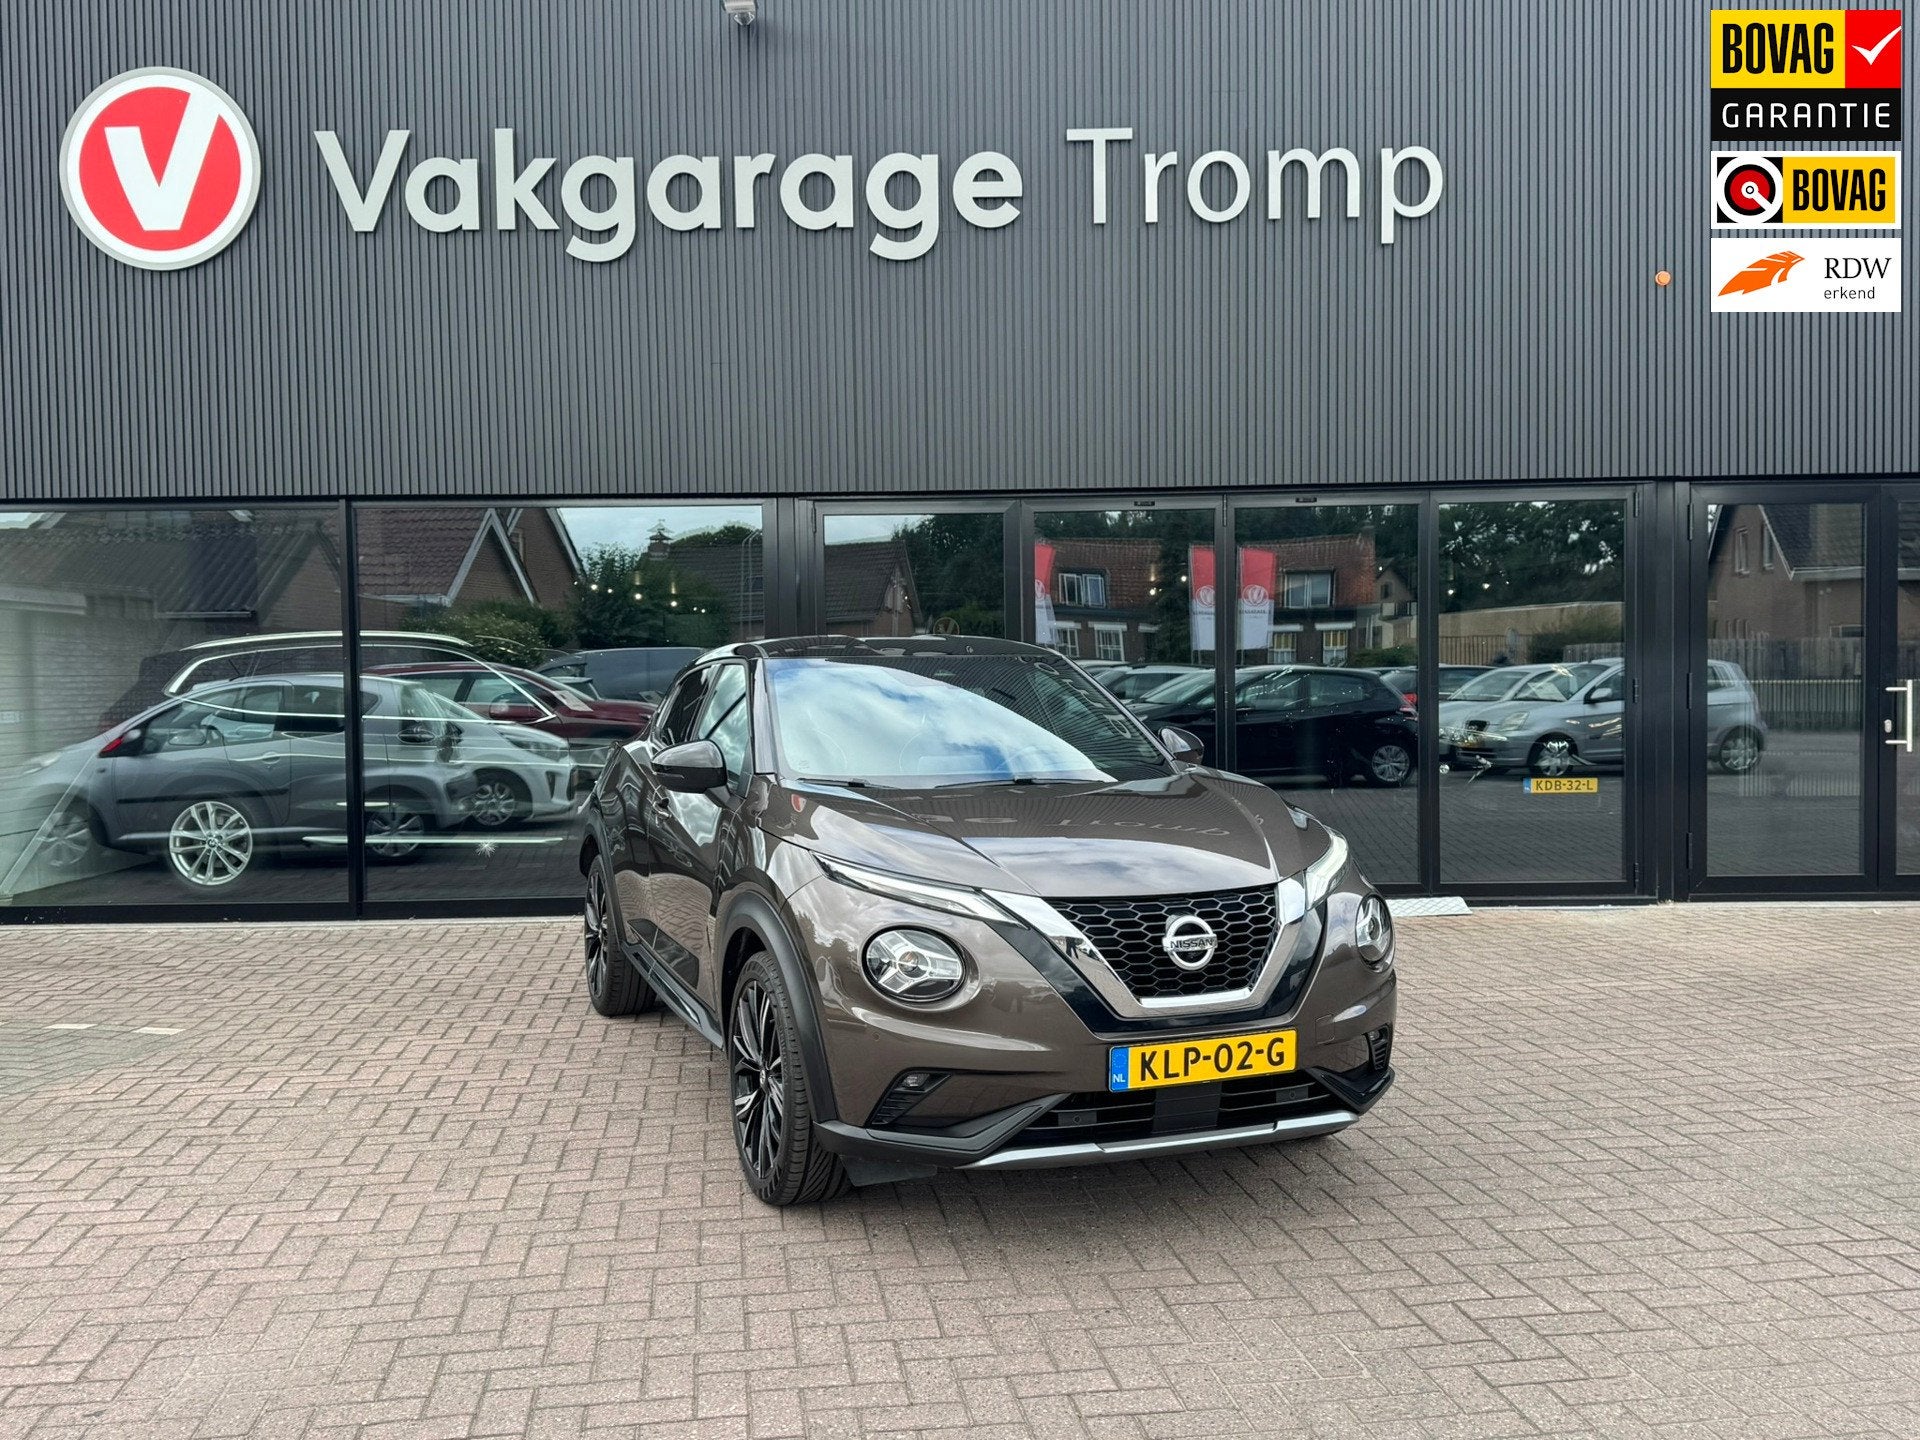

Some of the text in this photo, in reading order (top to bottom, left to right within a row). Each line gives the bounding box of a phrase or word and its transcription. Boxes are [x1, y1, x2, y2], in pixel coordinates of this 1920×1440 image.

[313, 127, 1444, 262] Vakgarage Tromp
[1535, 780, 1593, 791] KDB-32-L
[1170, 938, 1213, 949] NISSAN
[1112, 1037, 1285, 1083] NL KLP-02-G
